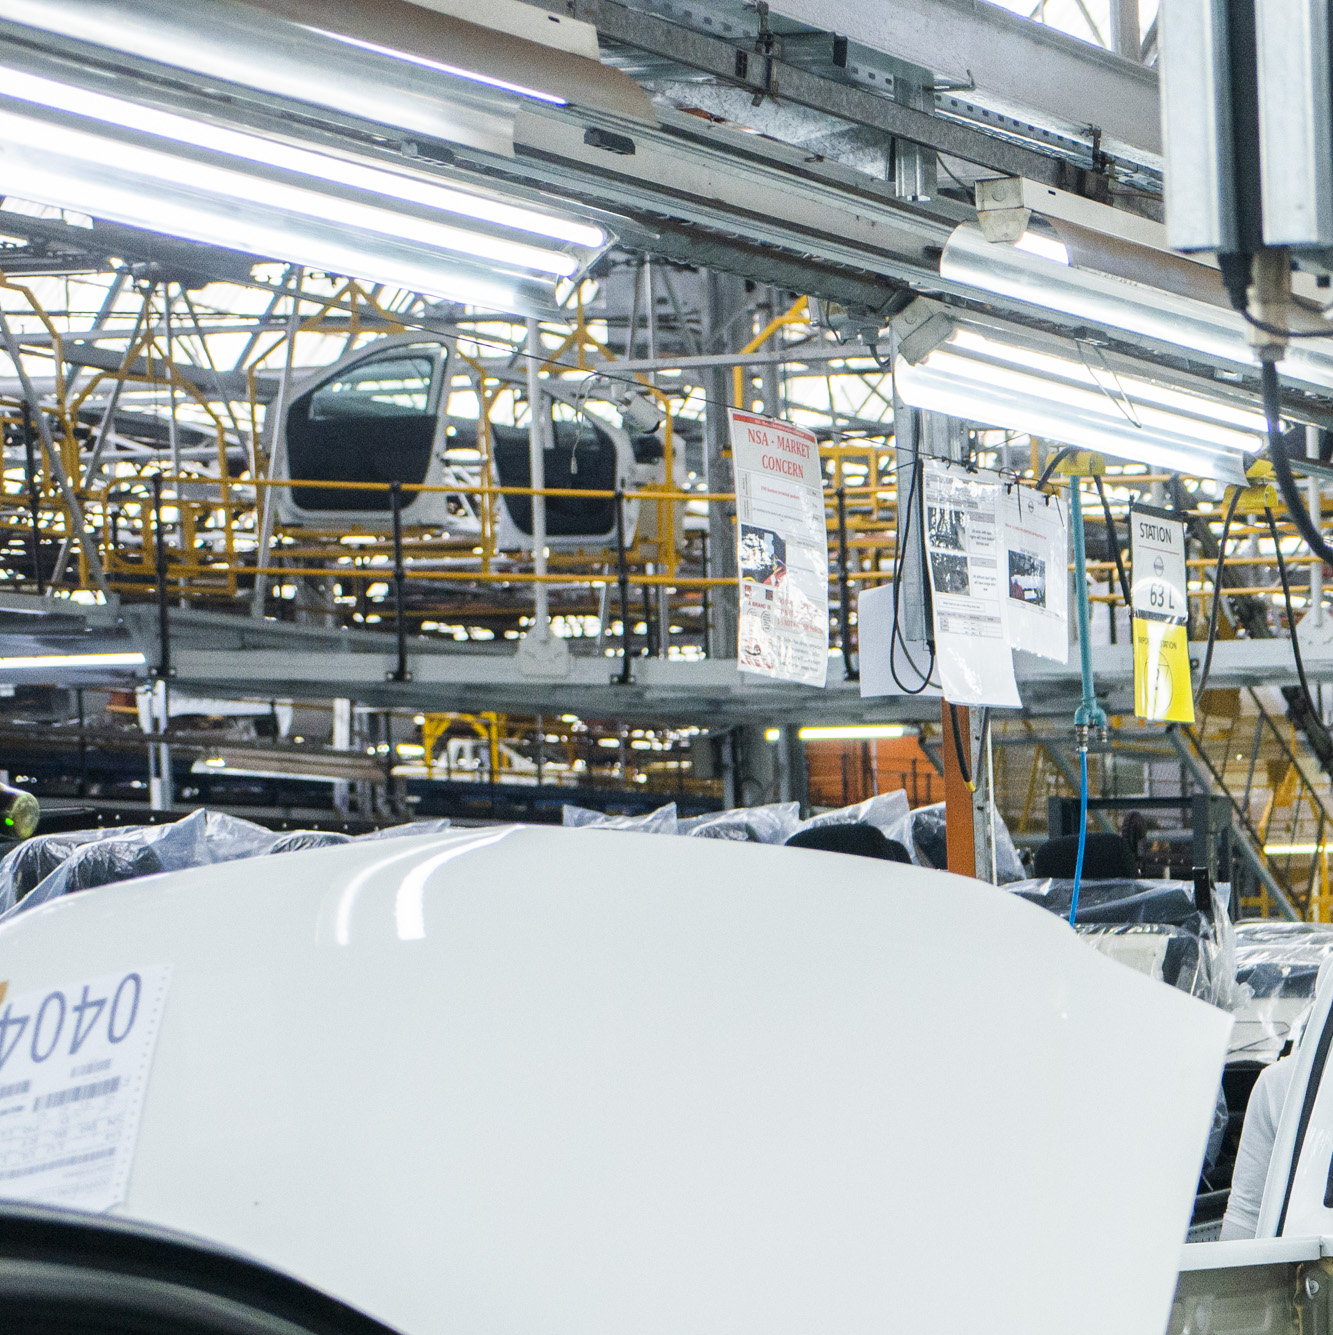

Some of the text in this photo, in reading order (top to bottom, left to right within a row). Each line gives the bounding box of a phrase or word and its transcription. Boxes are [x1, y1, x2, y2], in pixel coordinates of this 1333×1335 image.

[748, 428, 769, 446] NSA
[777, 435, 810, 458] MARKET
[761, 454, 804, 479] CONCERN
[1139, 521, 1172, 544] STATION
[1150, 583, 1175, 610] 63 L
